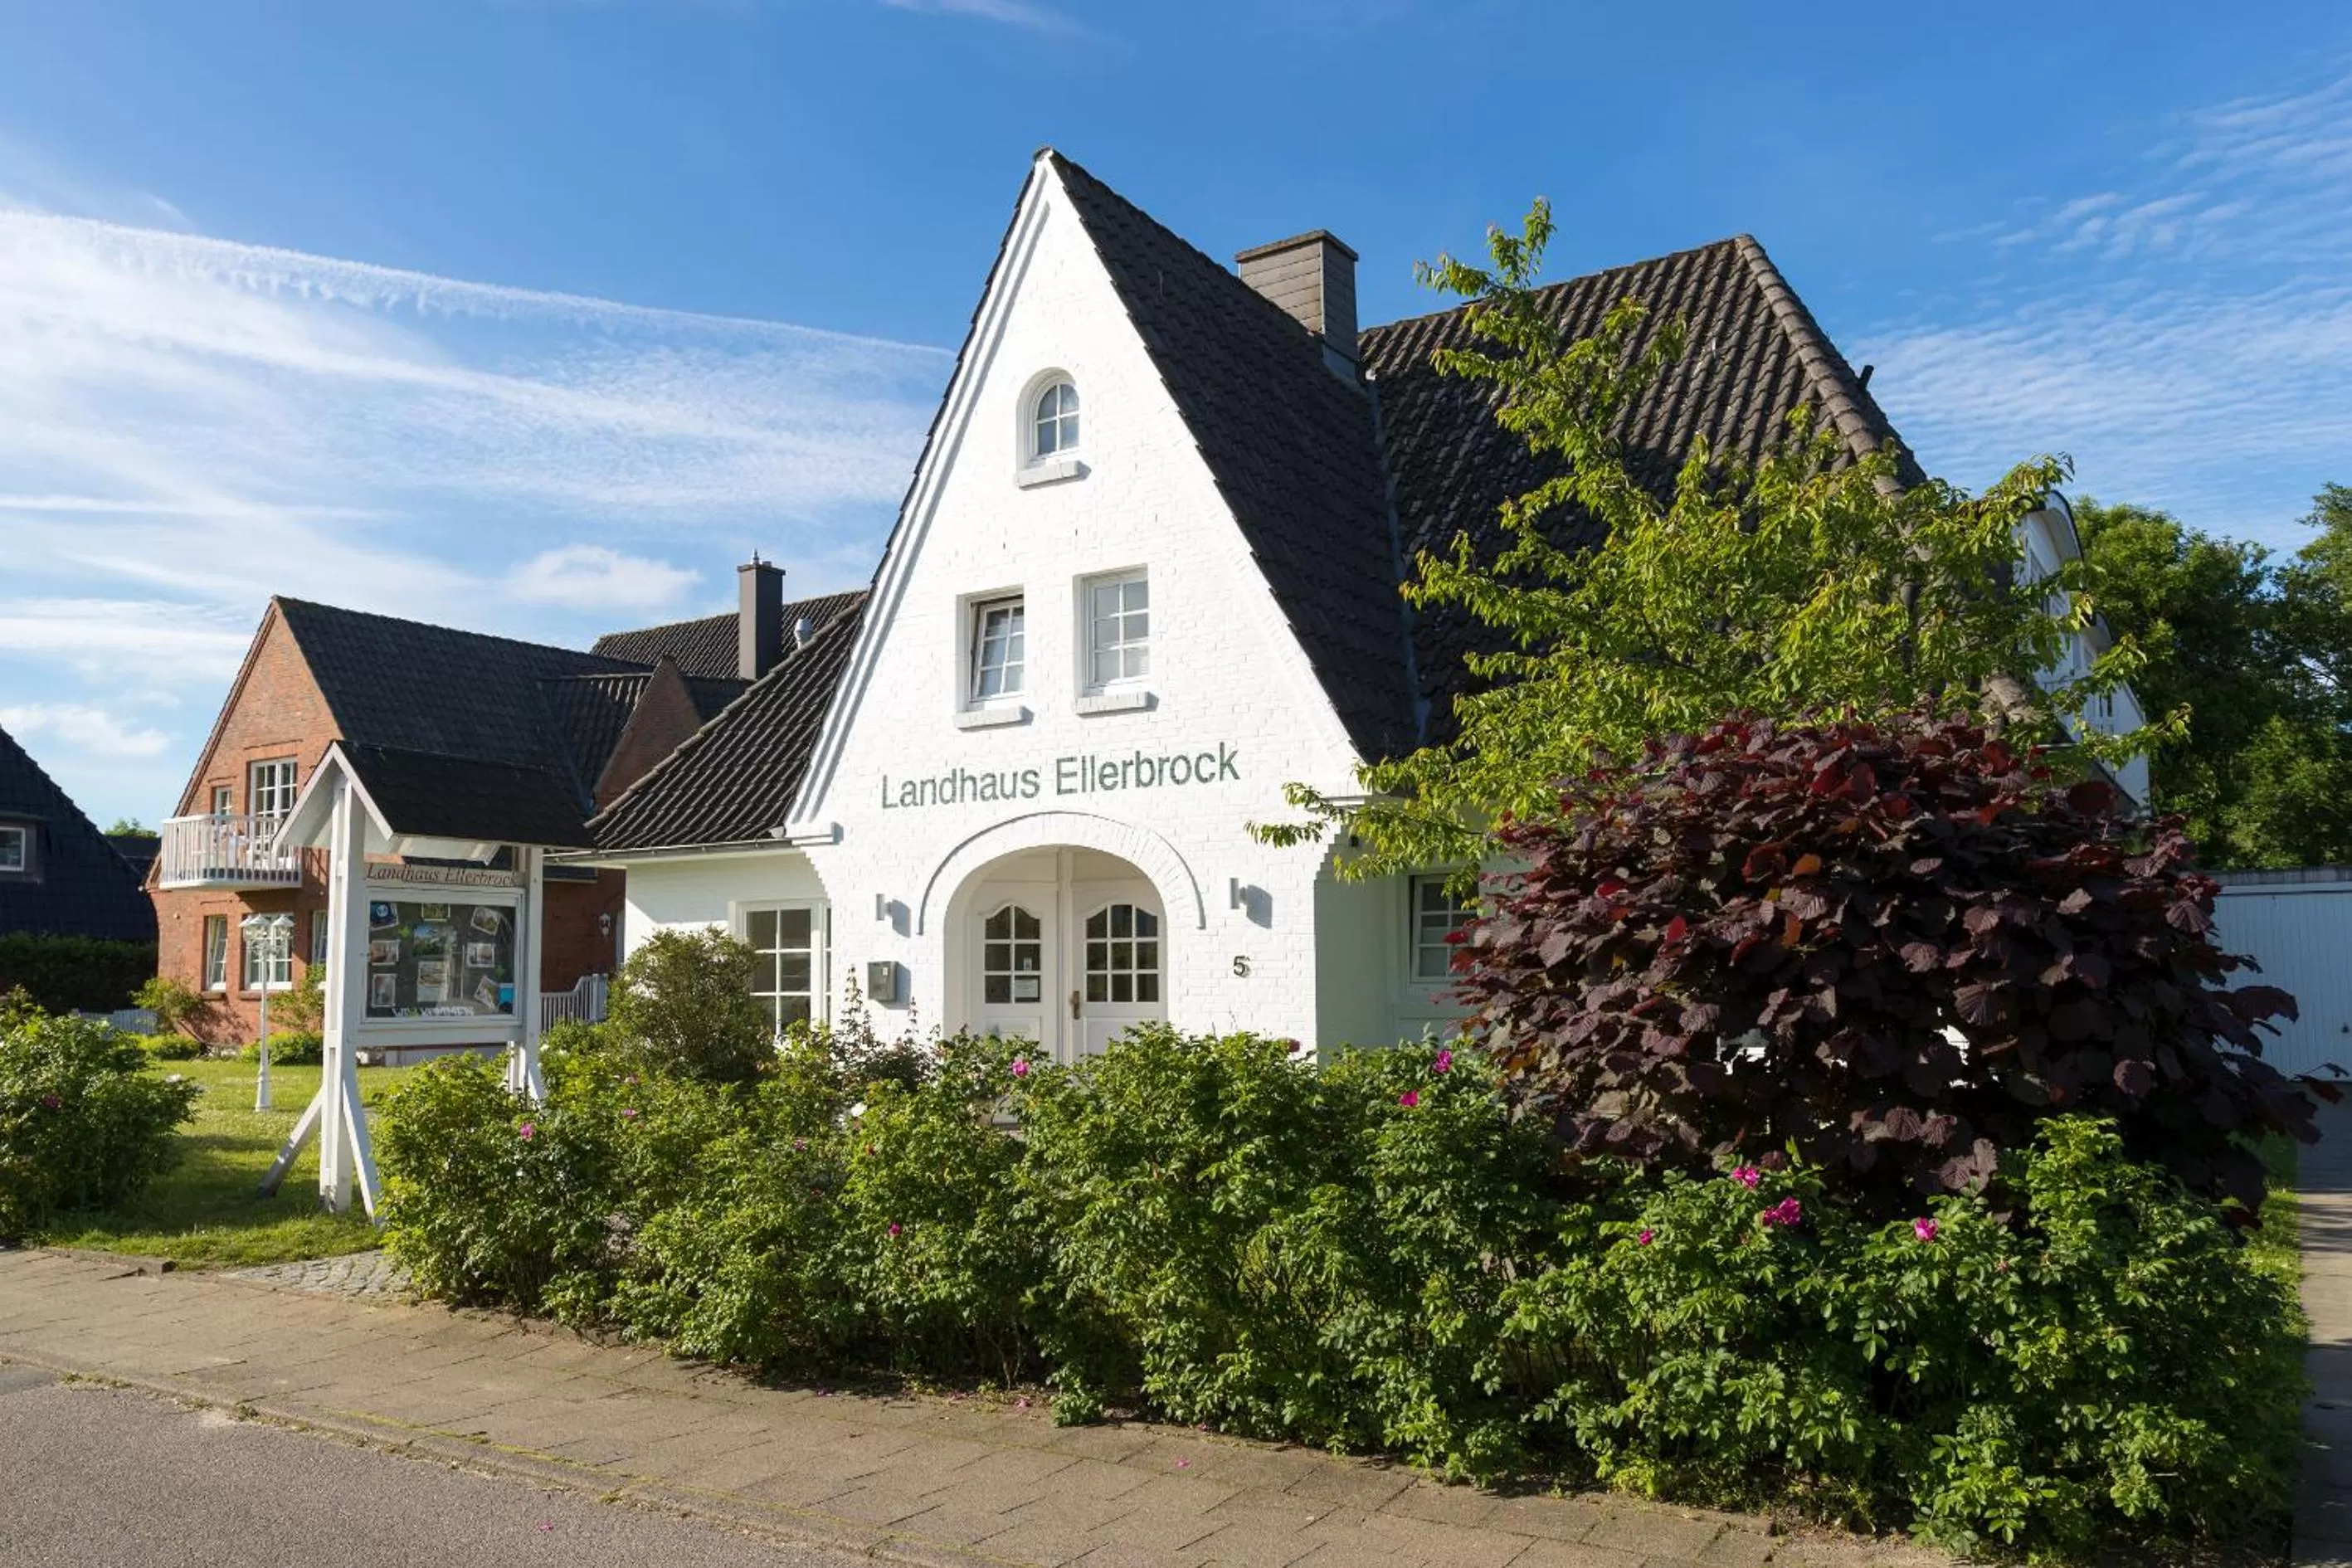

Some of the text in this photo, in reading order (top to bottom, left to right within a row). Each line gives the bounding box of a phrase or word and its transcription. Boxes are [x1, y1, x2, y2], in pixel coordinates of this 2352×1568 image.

[882, 742, 1241, 810] Landhaus Ellerbrock
[366, 863, 517, 887] Landhaus Ellerbrock
[1233, 956, 1247, 977] 5
